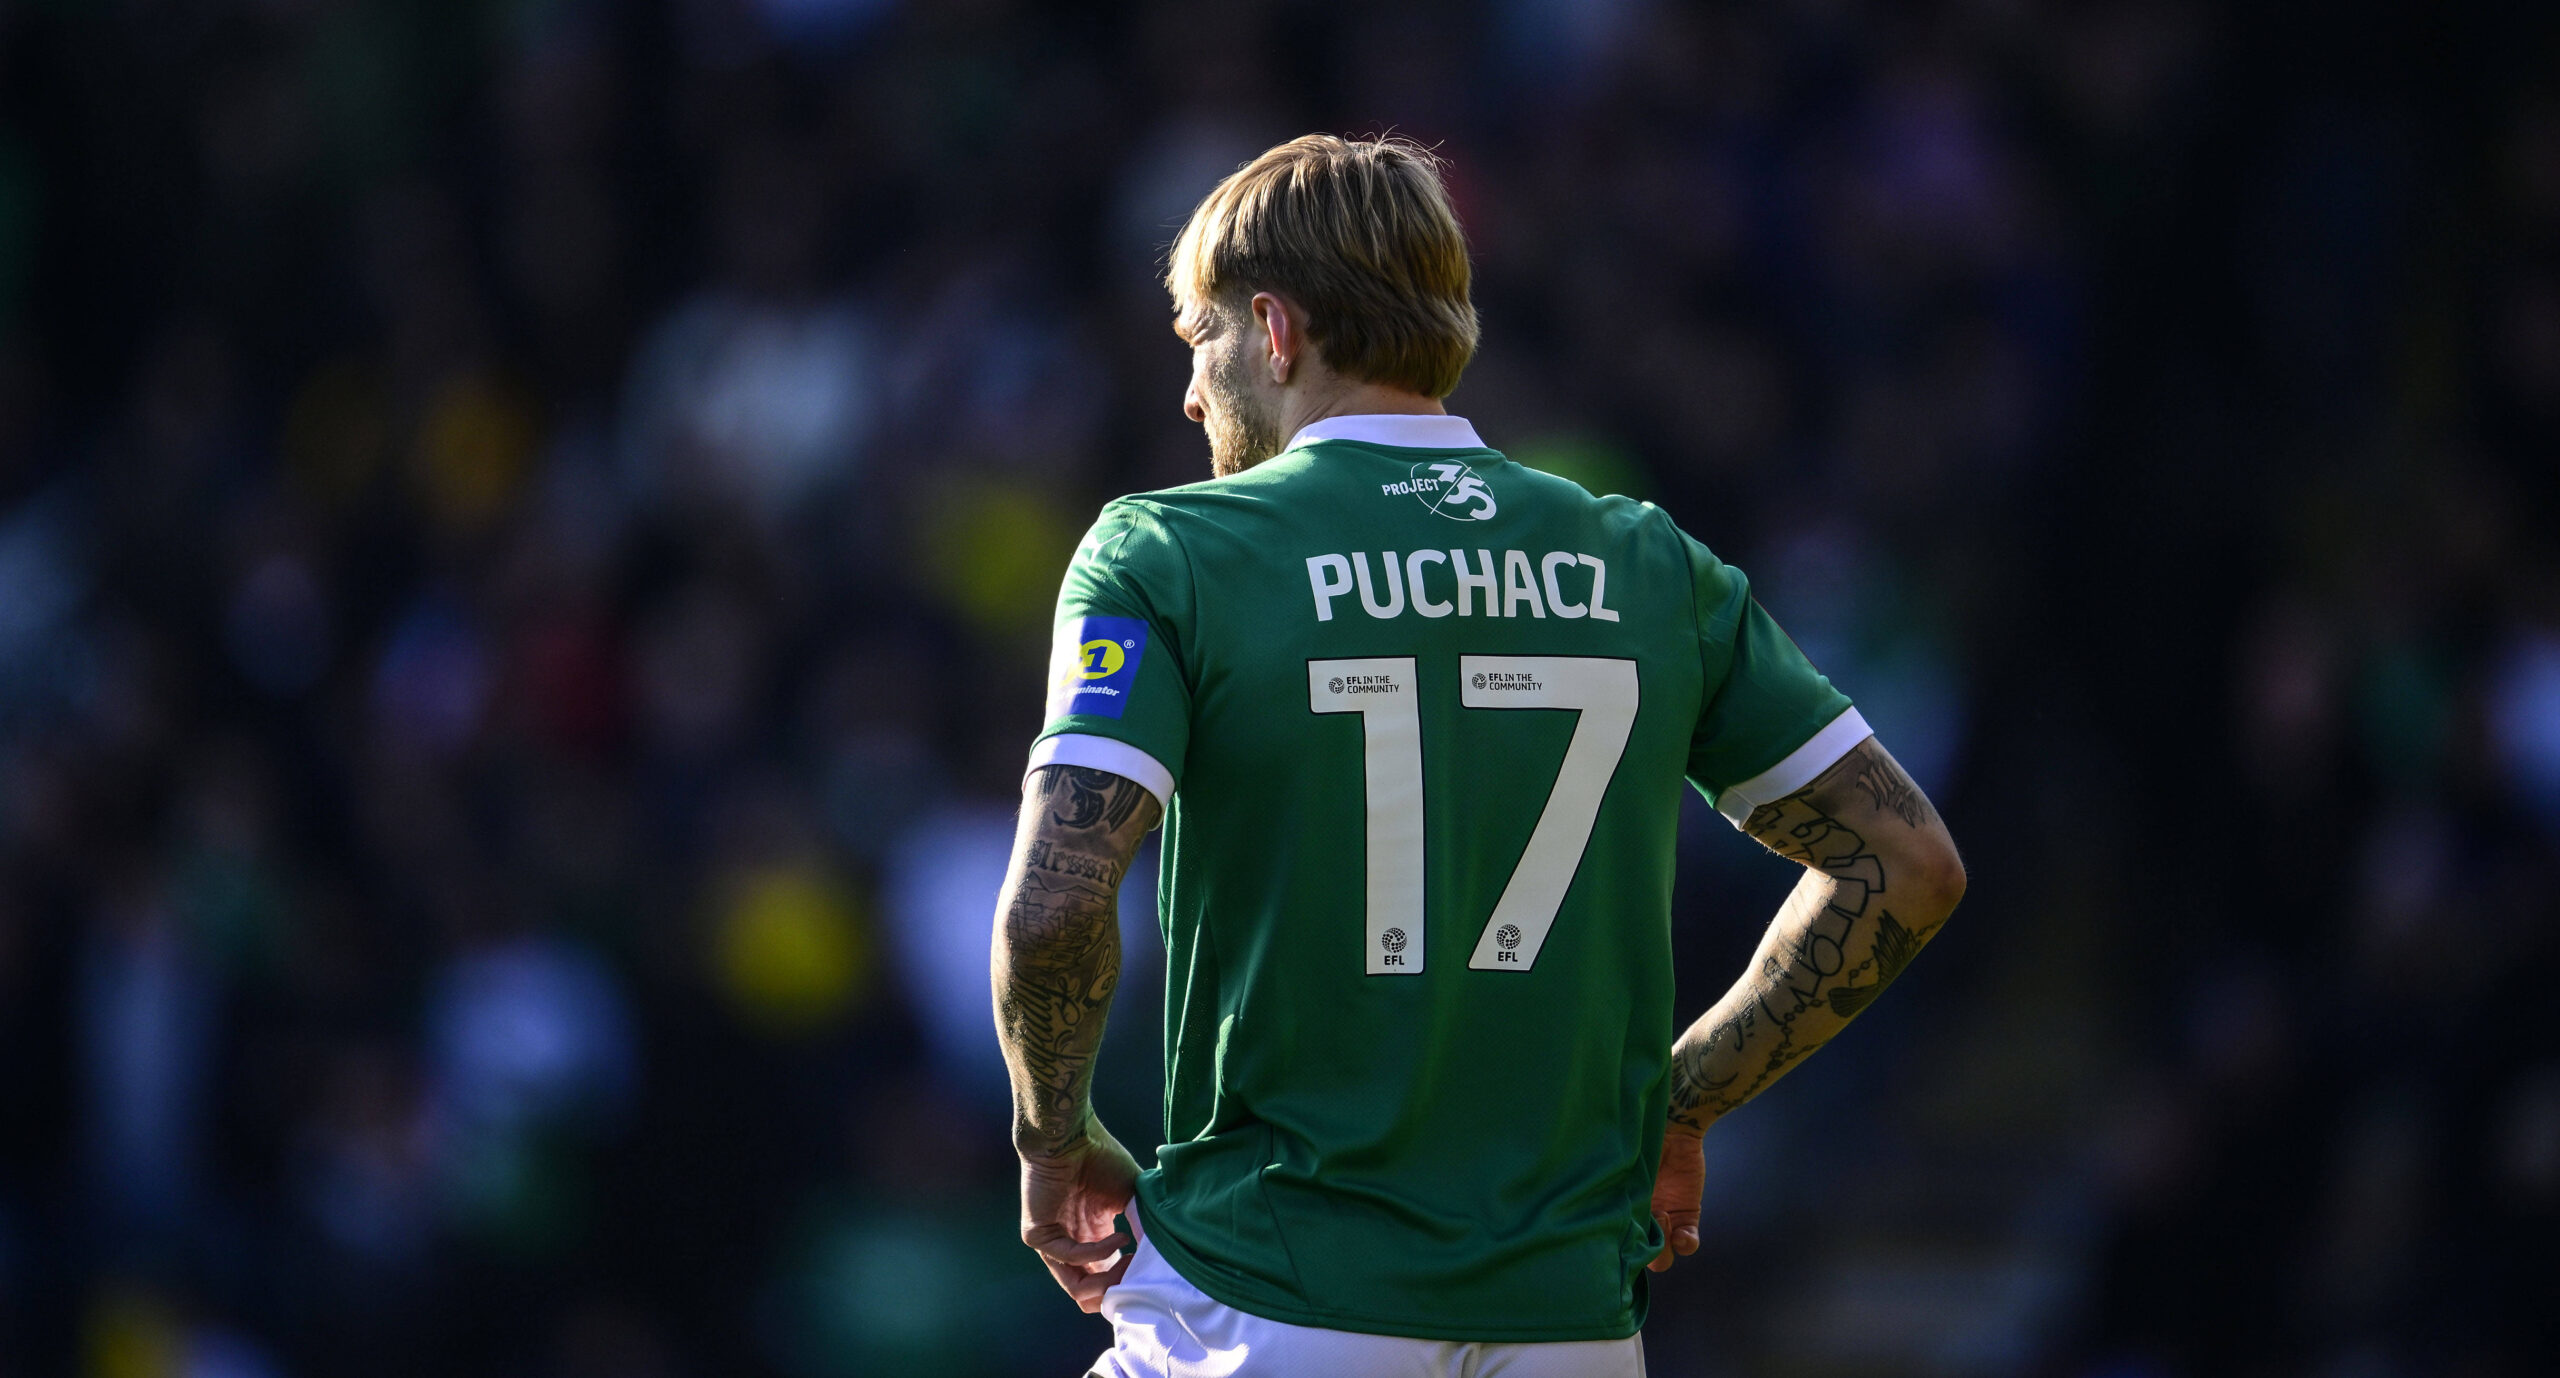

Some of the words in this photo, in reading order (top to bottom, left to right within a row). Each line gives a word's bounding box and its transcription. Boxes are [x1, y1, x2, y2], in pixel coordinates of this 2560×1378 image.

[1382, 478, 1439, 495] PROJECT
[1306, 549, 1620, 622] PUCHACZ
[1346, 676, 1362, 685] EFL
[1363, 676, 1373, 684] IN
[1375, 675, 1391, 684] THE
[1488, 673, 1504, 682] EFL
[1505, 673, 1515, 682] IN
[1516, 673, 1533, 682] THE
[1347, 684, 1399, 693] COMMUNITY
[1489, 682, 1543, 691] COMMUNITY
[1306, 653, 1641, 976] 17
[1384, 955, 1404, 965] EFL
[1497, 951, 1518, 962] EFL
